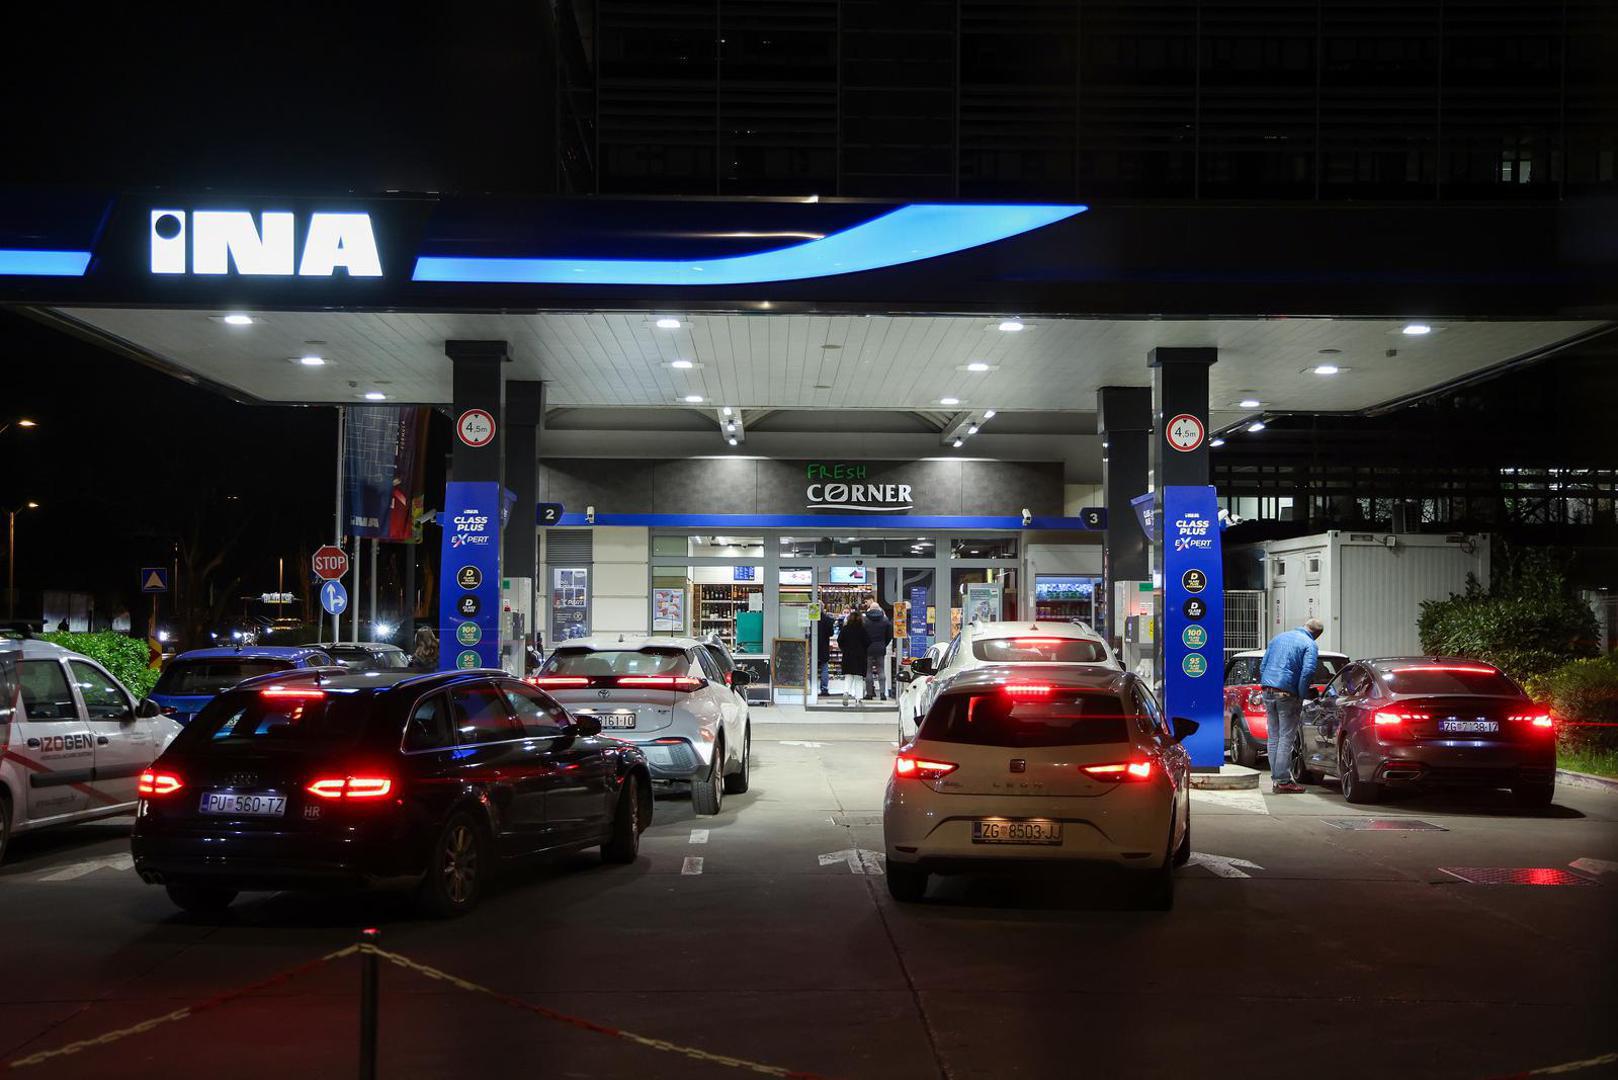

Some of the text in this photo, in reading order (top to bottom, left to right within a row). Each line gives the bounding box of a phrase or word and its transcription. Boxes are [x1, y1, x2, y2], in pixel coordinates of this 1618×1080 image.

[807, 464, 866, 479] FRESH
[806, 483, 913, 503] CORNER
[453, 516, 488, 524] CLASS
[545, 509, 555, 519] 2
[1089, 513, 1099, 524] 3
[1175, 520, 1209, 528] CLASS
[315, 556, 346, 570] STOP
[1190, 572, 1199, 580] D
[40, 734, 93, 752] IZOGEN
[209, 796, 284, 813] PU 560-TZ
[304, 806, 320, 817] HR
[982, 824, 1062, 839] ZG 8503-JJ
